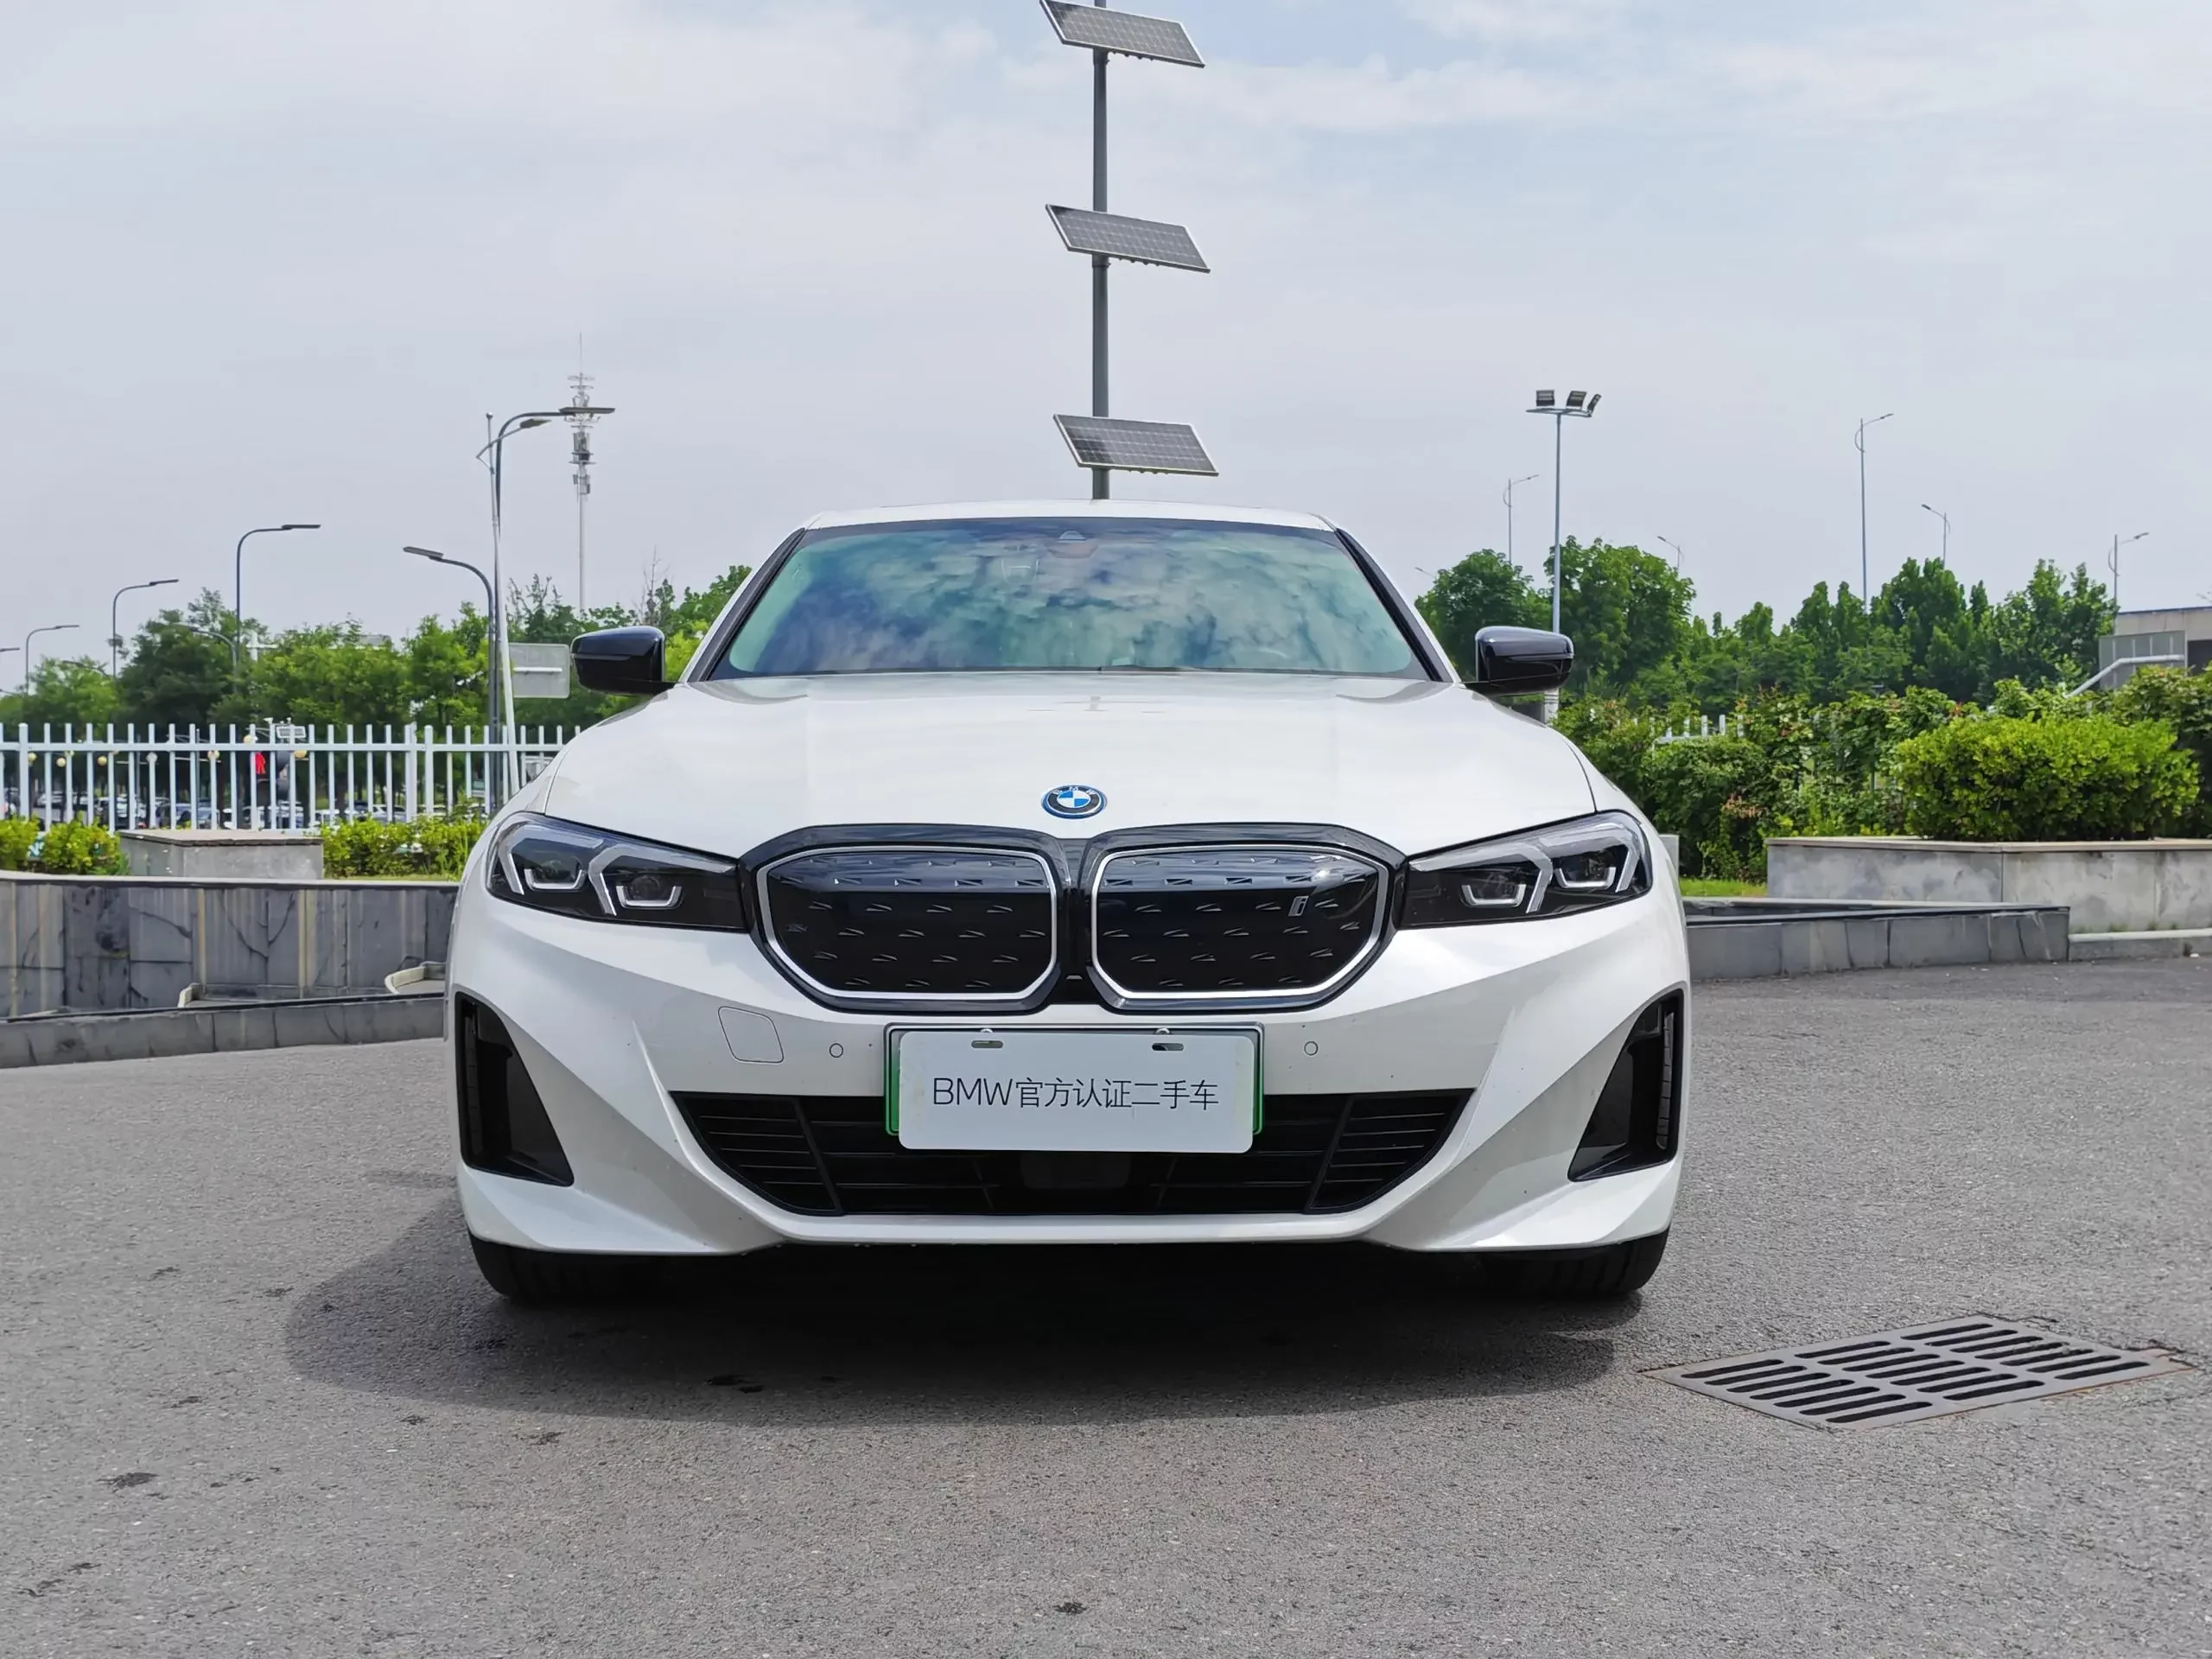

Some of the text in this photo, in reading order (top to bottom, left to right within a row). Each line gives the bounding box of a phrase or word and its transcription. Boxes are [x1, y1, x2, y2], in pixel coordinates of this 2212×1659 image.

[1052, 785, 1097, 795] BMW
[933, 1077, 1219, 1110] BMW官方认证二手车
